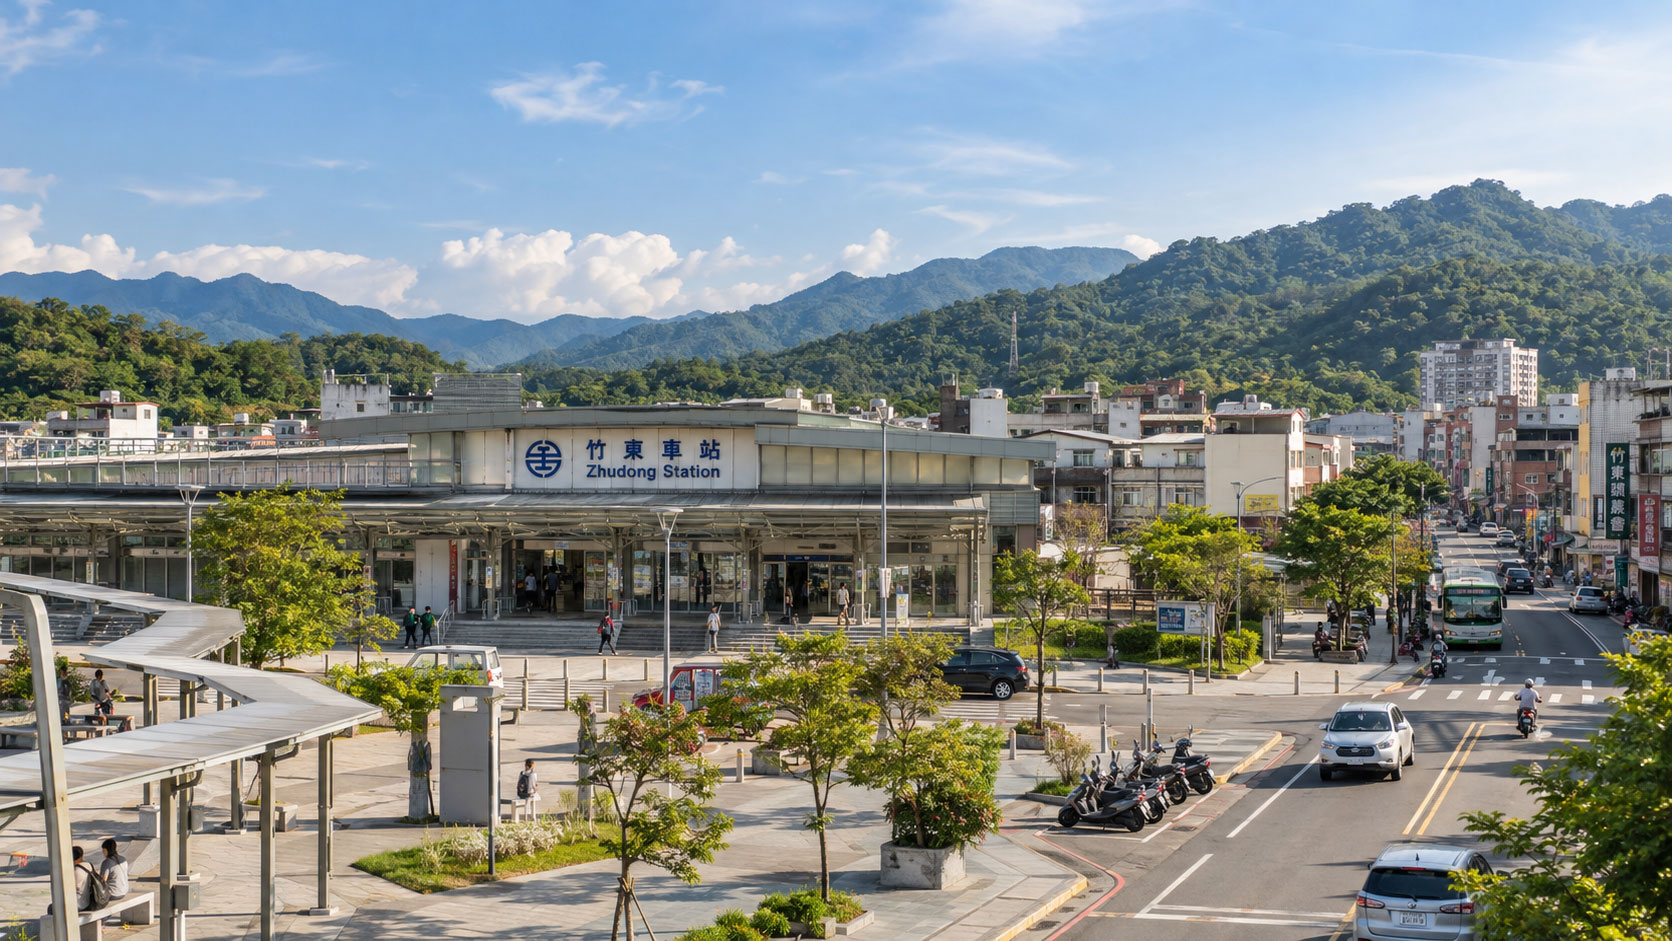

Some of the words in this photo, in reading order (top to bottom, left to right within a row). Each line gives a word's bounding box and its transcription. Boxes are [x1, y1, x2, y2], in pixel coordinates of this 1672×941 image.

[586, 439, 720, 460] 竹東車站
[586, 464, 656, 480] Zhudong
[663, 464, 720, 478] Station
